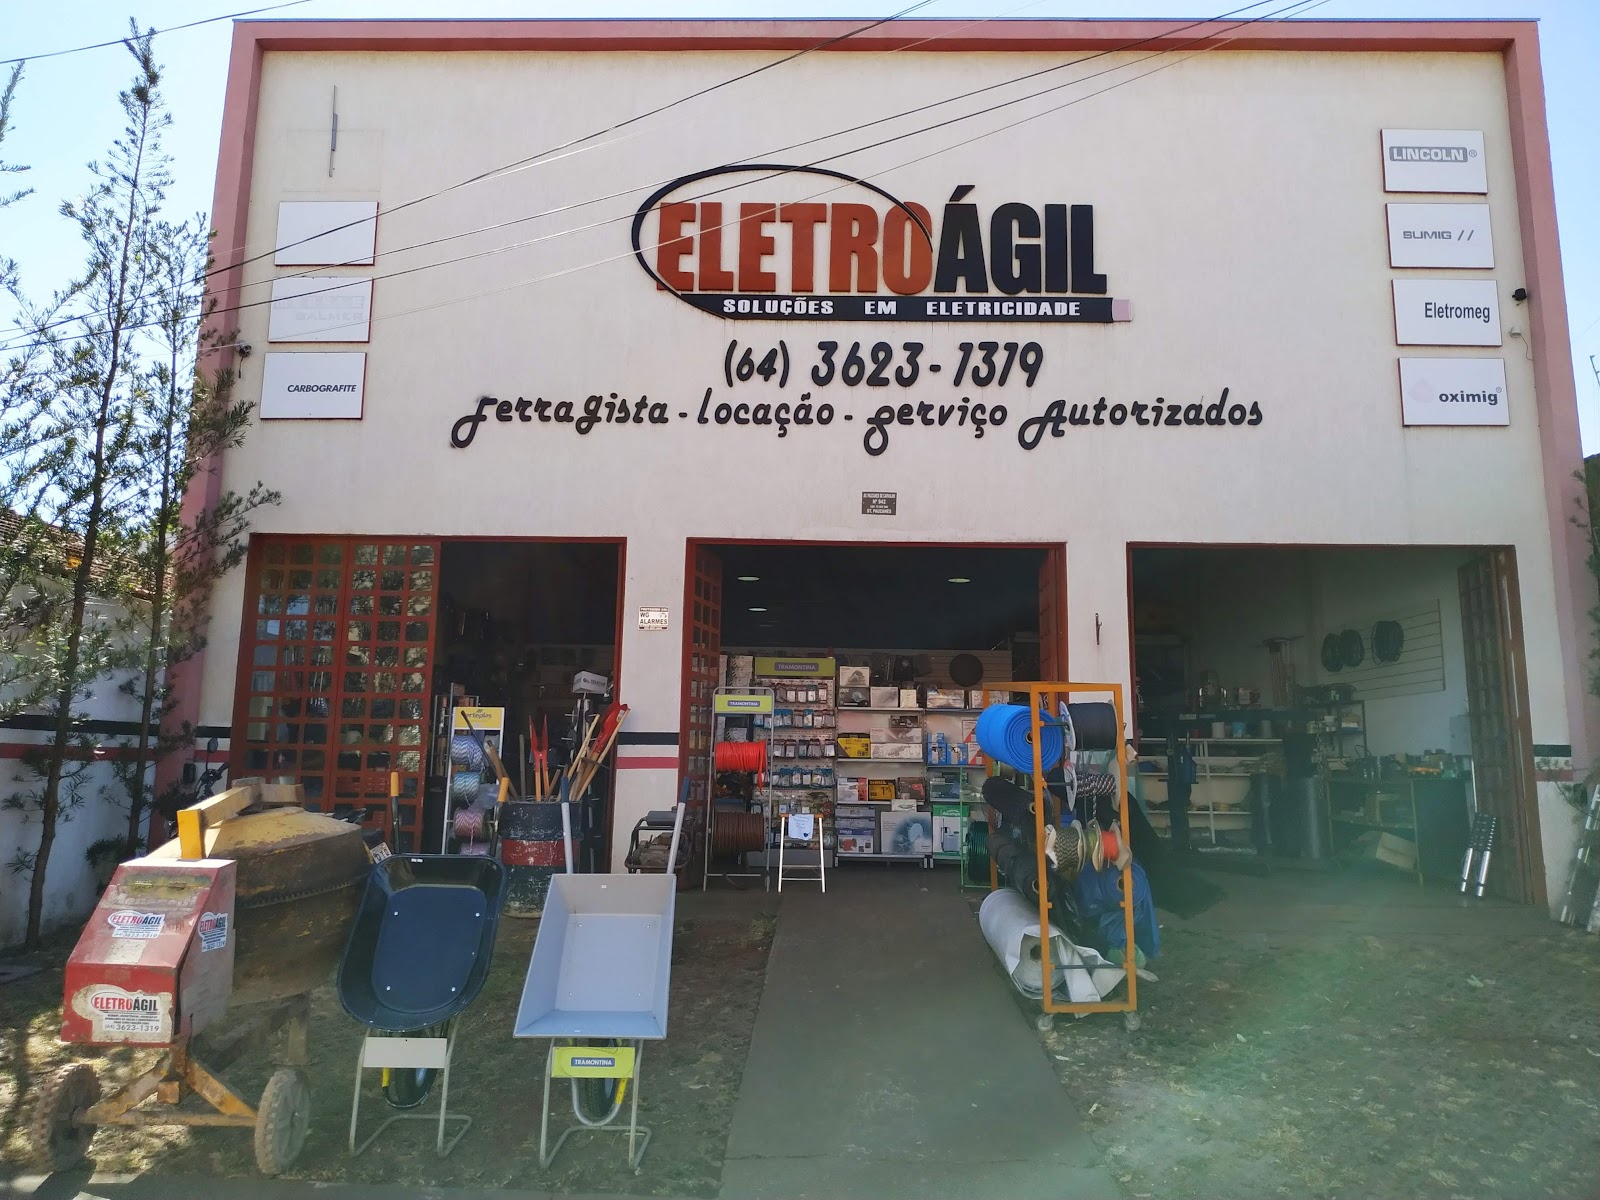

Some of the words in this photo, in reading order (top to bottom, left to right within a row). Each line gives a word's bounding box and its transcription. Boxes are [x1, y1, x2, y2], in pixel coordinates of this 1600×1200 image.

[1392, 148, 1464, 161] LINCOLN
[656, 185, 1107, 294] ELETROÁGIL
[1402, 231, 1452, 240] SUMIG
[723, 297, 834, 316] SOLUÇÕES
[864, 301, 897, 315] EM
[926, 301, 1081, 316] ELETRICIDADE
[1424, 302, 1491, 324] Eletromeg
[724, 339, 790, 389] (64)
[287, 384, 357, 393] CARBOGRAFITE
[1438, 390, 1499, 406] oximig
[450, 393, 670, 449] Ferragista
[1017, 387, 1263, 451] Autorizados
[777, 663, 816, 671] TRAMONTINA
[112, 915, 163, 925] ELETROÁGIL
[93, 996, 158, 1011] ELETROÁGIL
[116, 1024, 160, 1032] 3623-1319
